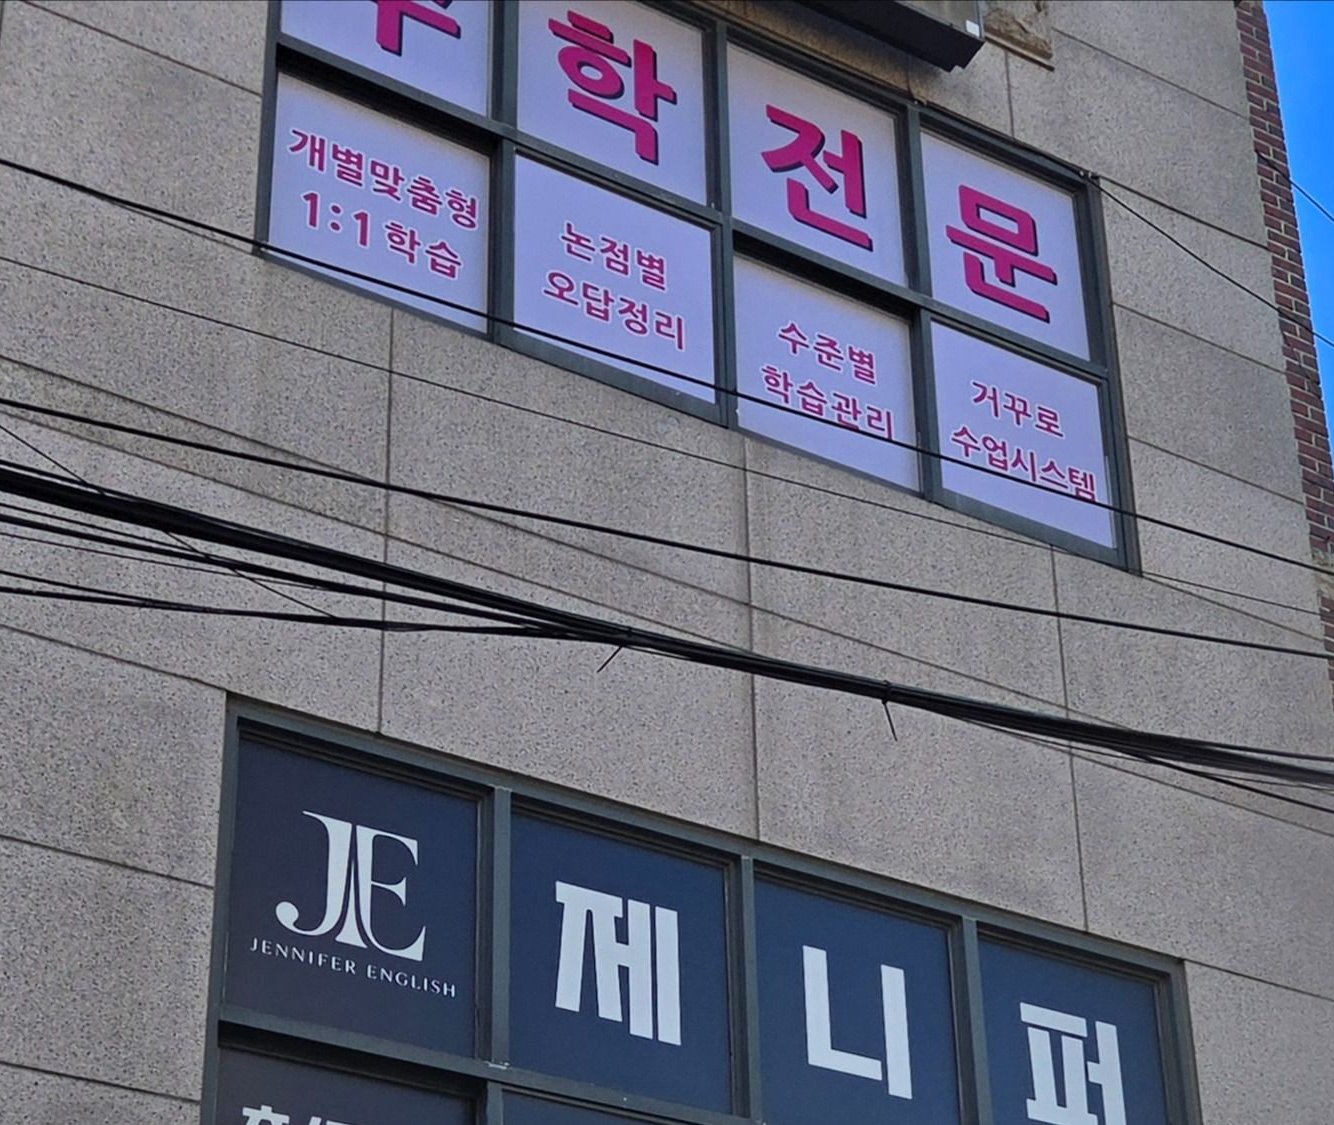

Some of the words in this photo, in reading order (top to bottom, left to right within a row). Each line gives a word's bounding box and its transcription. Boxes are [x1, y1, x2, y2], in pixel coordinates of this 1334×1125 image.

[288, 129, 478, 229] 개별맞춤형
[302, 192, 369, 247] 1:1
[383, 221, 462, 280] 학습
[560, 222, 667, 291] 논점별
[543, 271, 684, 351] 오답정리
[778, 322, 877, 386] 수준별
[761, 365, 894, 441] 학습관리
[971, 381, 1065, 438] 거꾸로
[950, 426, 1097, 503] 수업시스템
[275, 810, 427, 962] JE
[249, 938, 357, 976] JENNIFER
[367, 964, 457, 998] ENGLISH
